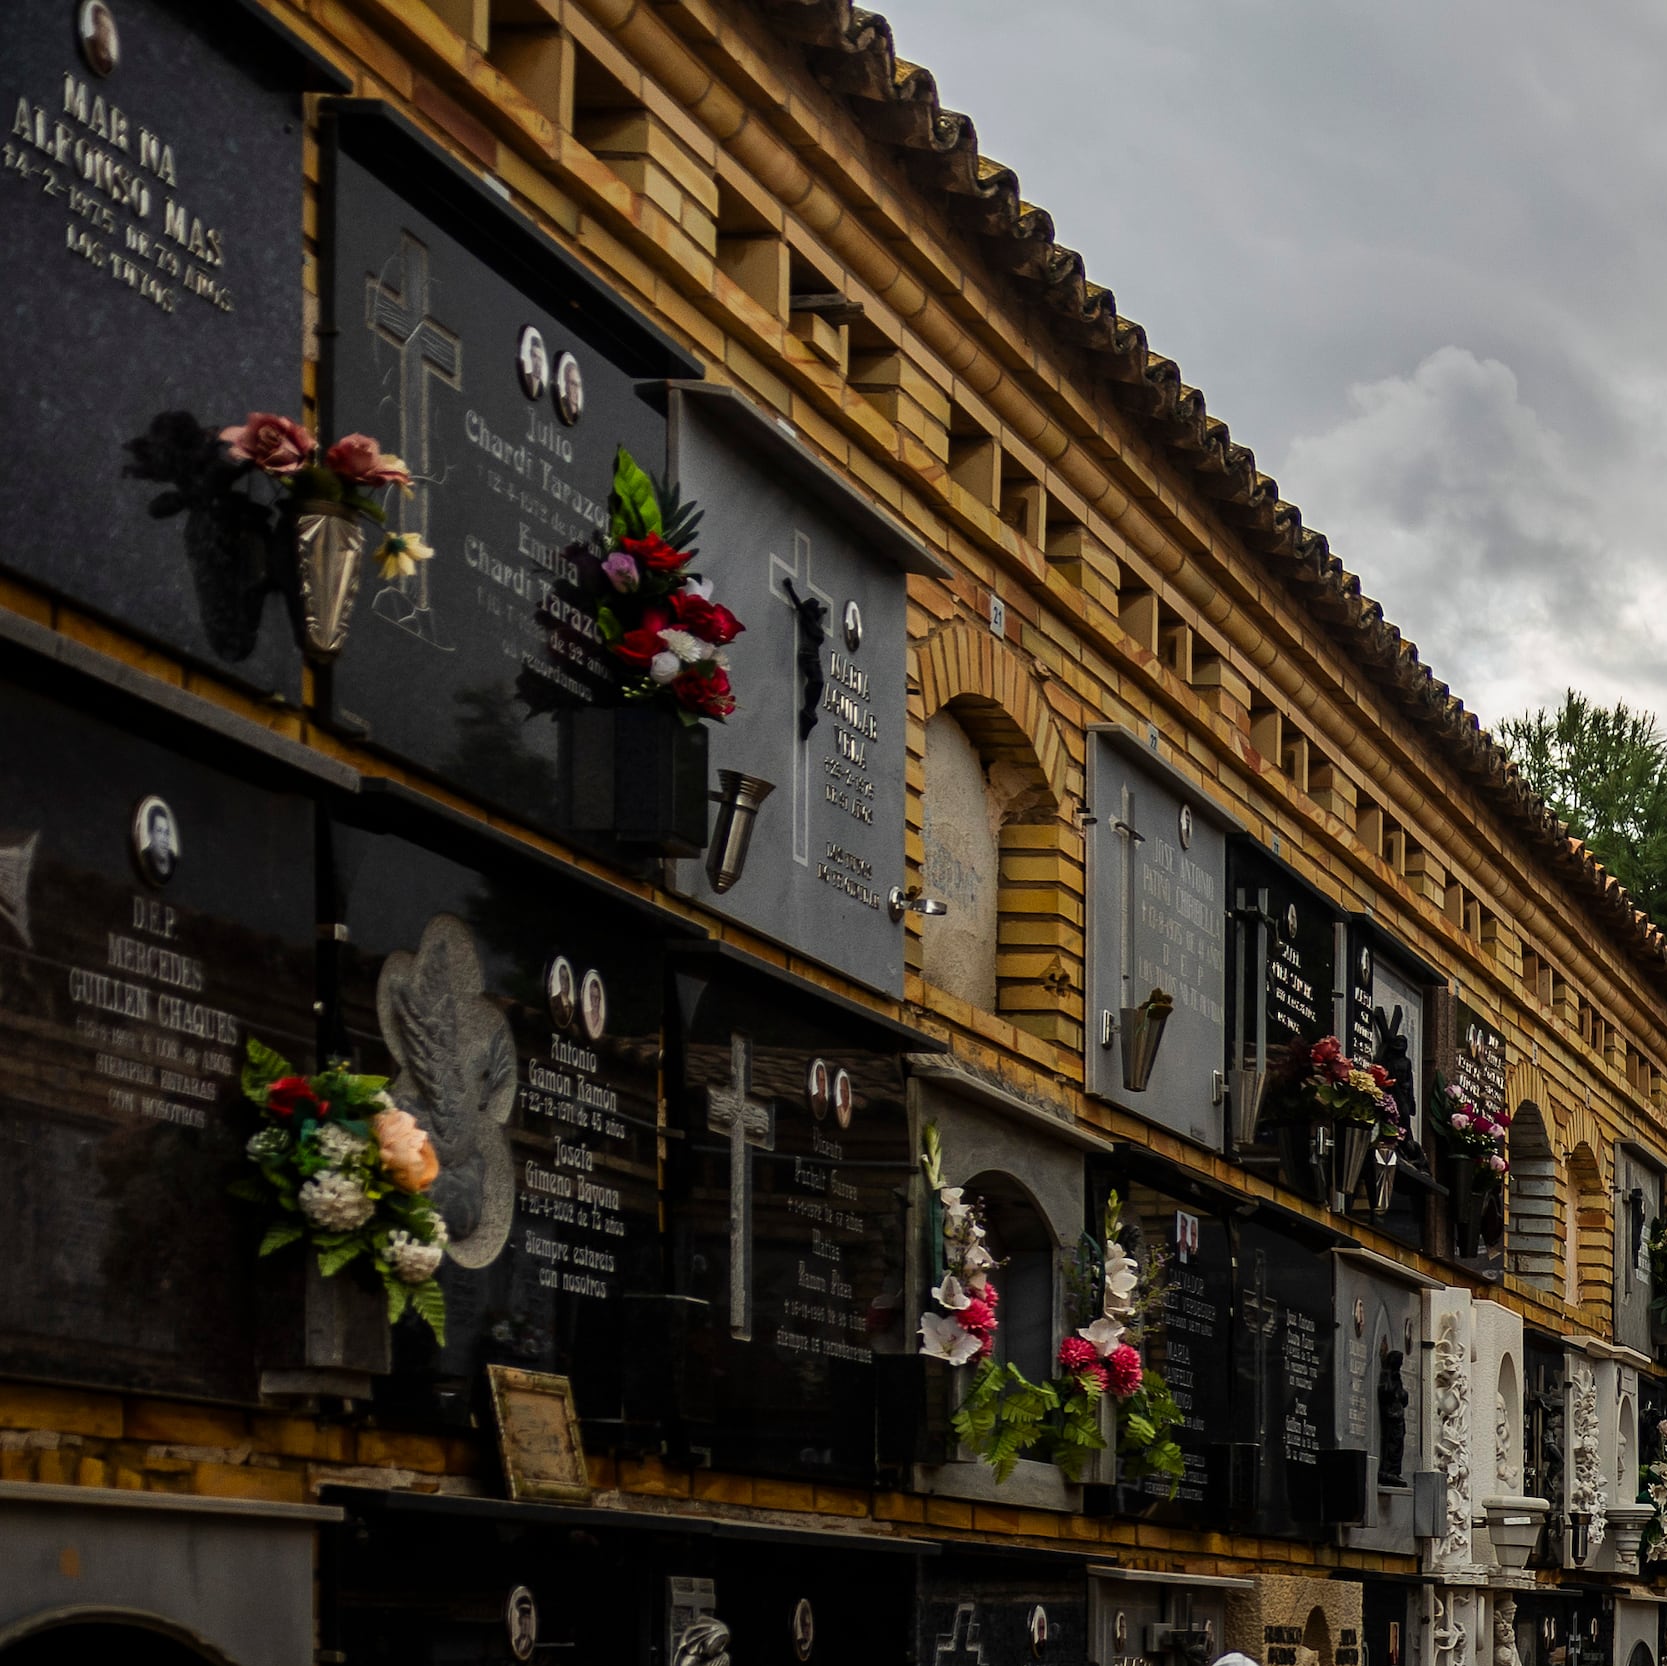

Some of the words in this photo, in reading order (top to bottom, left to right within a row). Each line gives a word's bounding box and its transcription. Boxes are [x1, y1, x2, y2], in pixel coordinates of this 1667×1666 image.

[12, 96, 151, 218] ALFONSO
[164, 194, 222, 268] MAS
[525, 405, 573, 463] Julio
[518, 519, 579, 588] Emilia
[107, 931, 204, 993] MERCEDES
[158, 992, 238, 1046] CHAQUES
[551, 1032, 597, 1073] Antonio
[528, 1057, 572, 1097] Gamón
[576, 1072, 618, 1113] Ramón
[554, 1135, 593, 1172] Josefa
[525, 1159, 572, 1198] Gimeno
[577, 1174, 620, 1211] Bayona
[525, 1229, 569, 1265] Siempre
[573, 1245, 616, 1273] estareis
[539, 1267, 558, 1288] con
[562, 1273, 607, 1299] nosotros
